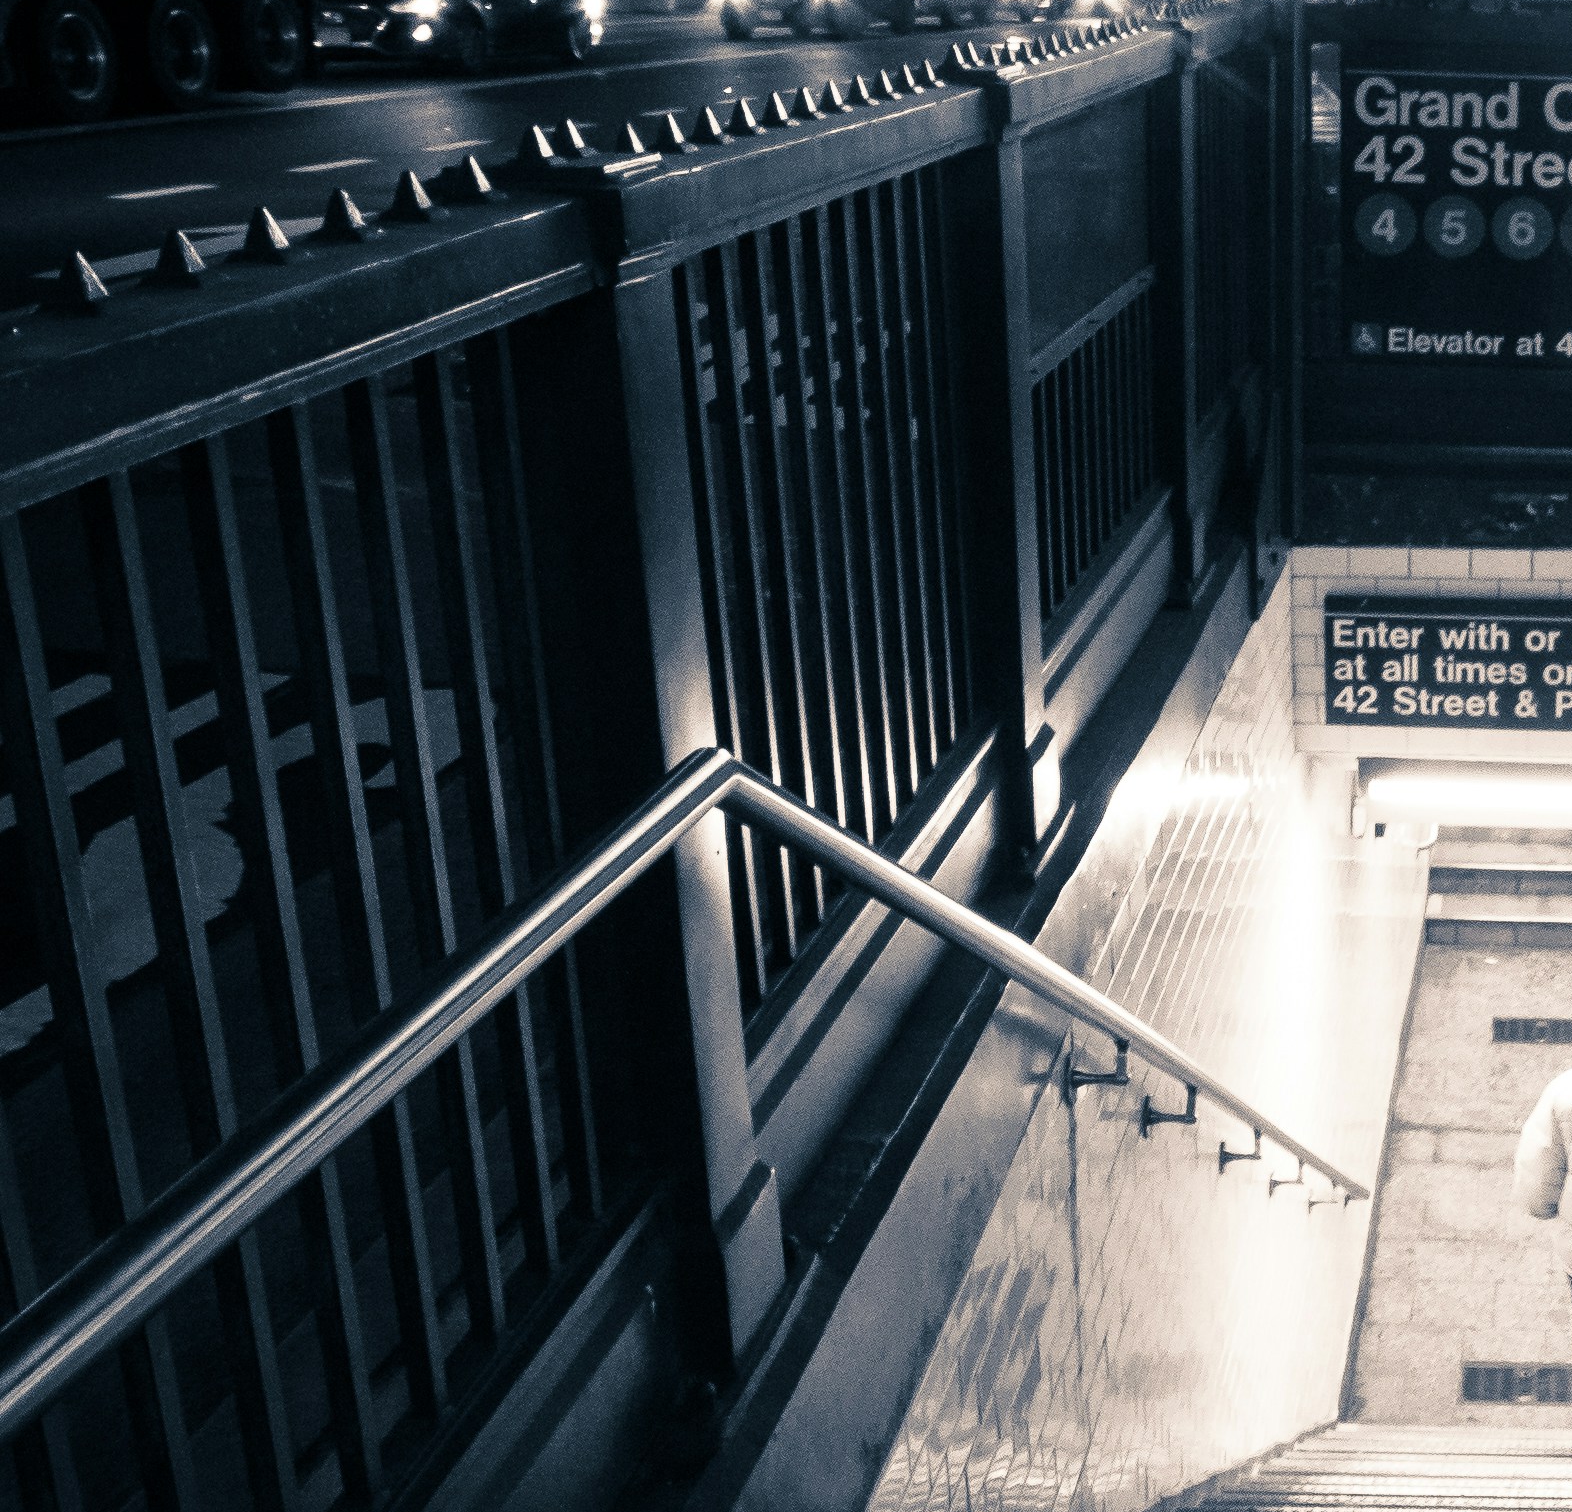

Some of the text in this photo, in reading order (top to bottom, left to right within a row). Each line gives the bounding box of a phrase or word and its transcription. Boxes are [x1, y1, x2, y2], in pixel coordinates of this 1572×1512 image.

[1354, 75, 1519, 129] Grand
[1353, 134, 1427, 184] 42
[1371, 208, 1397, 242] 4
[1441, 210, 1468, 245] 5
[1507, 211, 1536, 246] 6
[1387, 327, 1504, 356] Elevator
[1515, 331, 1546, 356] at
[1332, 619, 1425, 650] Enter
[1440, 623, 1510, 652] with
[1523, 631, 1562, 652] or
[1332, 654, 1368, 682] at
[1380, 656, 1419, 683] all
[1433, 655, 1527, 686] times
[1332, 686, 1379, 715] 42
[1392, 687, 1499, 718] Street
[1514, 691, 1539, 719] &
